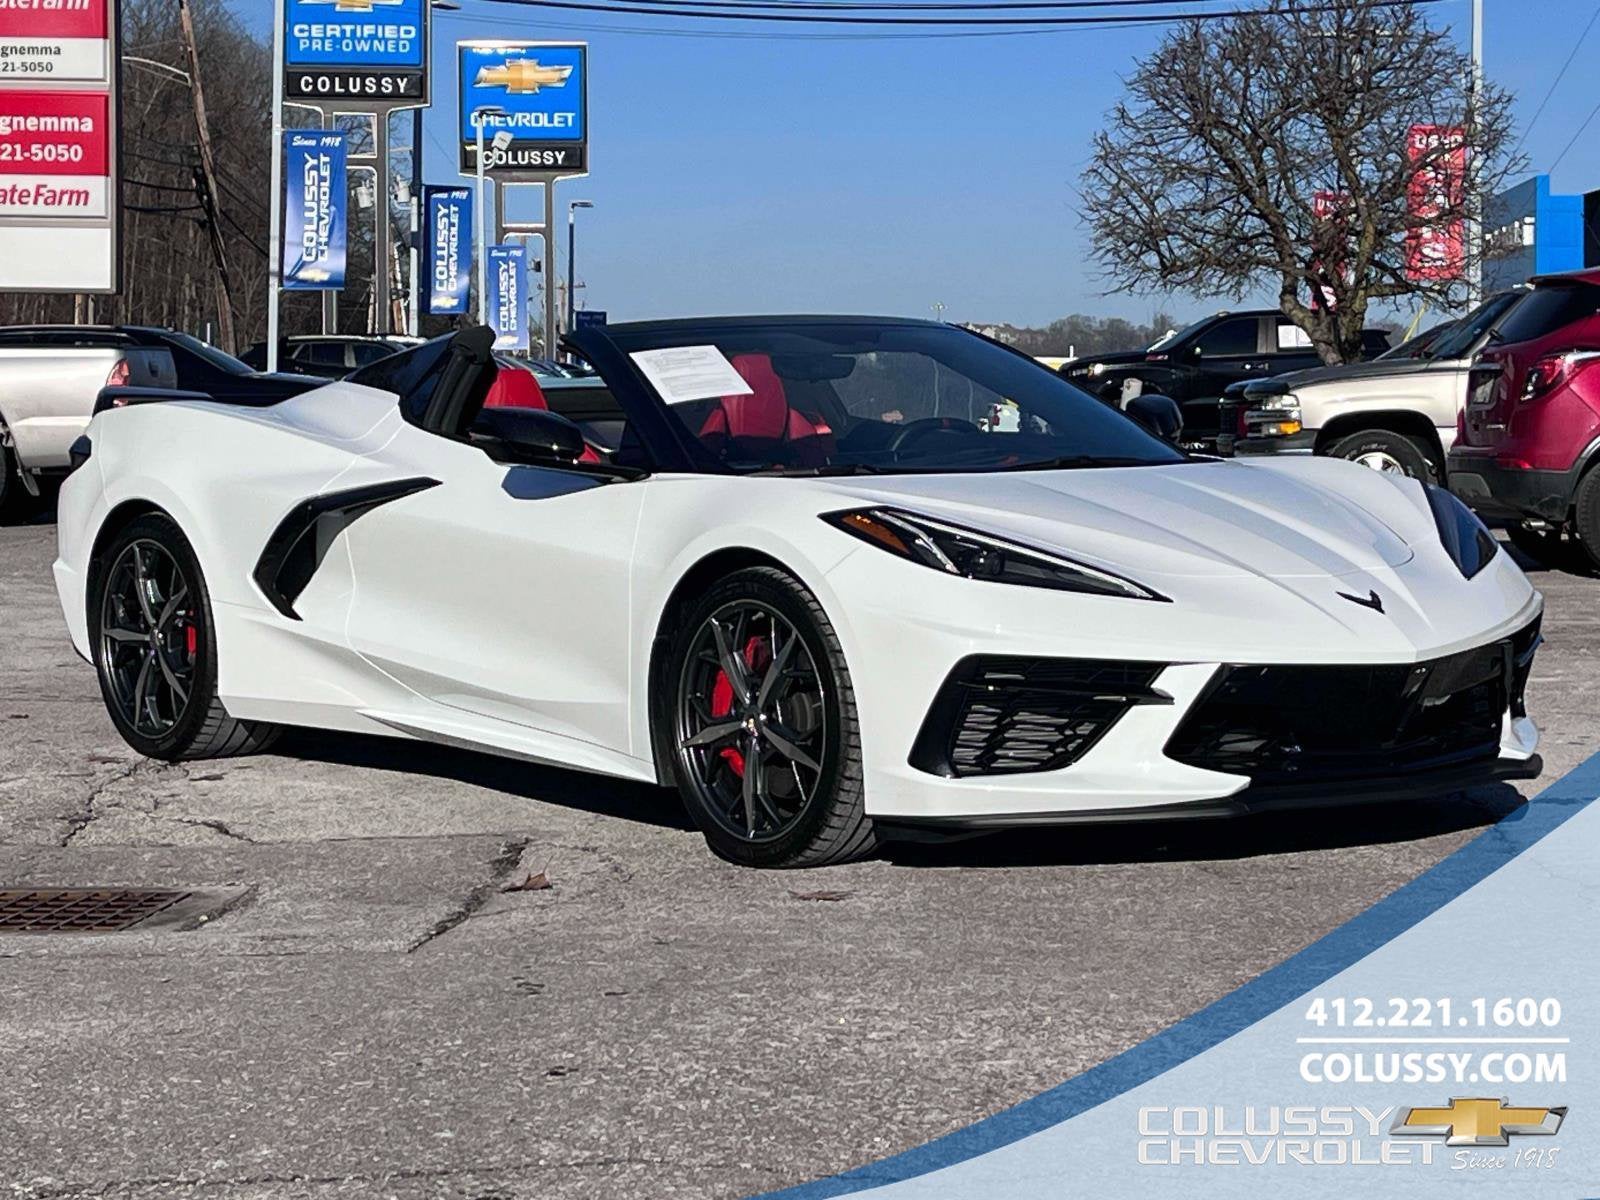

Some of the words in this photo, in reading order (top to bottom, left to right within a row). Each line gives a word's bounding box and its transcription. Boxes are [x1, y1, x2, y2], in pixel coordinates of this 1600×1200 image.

[293, 24, 416, 38] CERTIFIED
[1, 45, 61, 57] gnemma
[299, 39, 410, 52] PRE-OWNED
[2, 61, 53, 72] 21-5050
[300, 75, 408, 93] COLUSSY
[0, 116, 94, 135] gnemma
[470, 112, 575, 127] CHEVROLET
[0, 143, 83, 162] 21-5050
[482, 150, 565, 165] COLUSSY
[302, 152, 319, 262] COLUSSY
[318, 153, 331, 262] CHEVROLET
[436, 203, 449, 292] COLUSSY
[448, 204, 459, 292] CHEVROLET
[499, 260, 509, 332] COLUSSY
